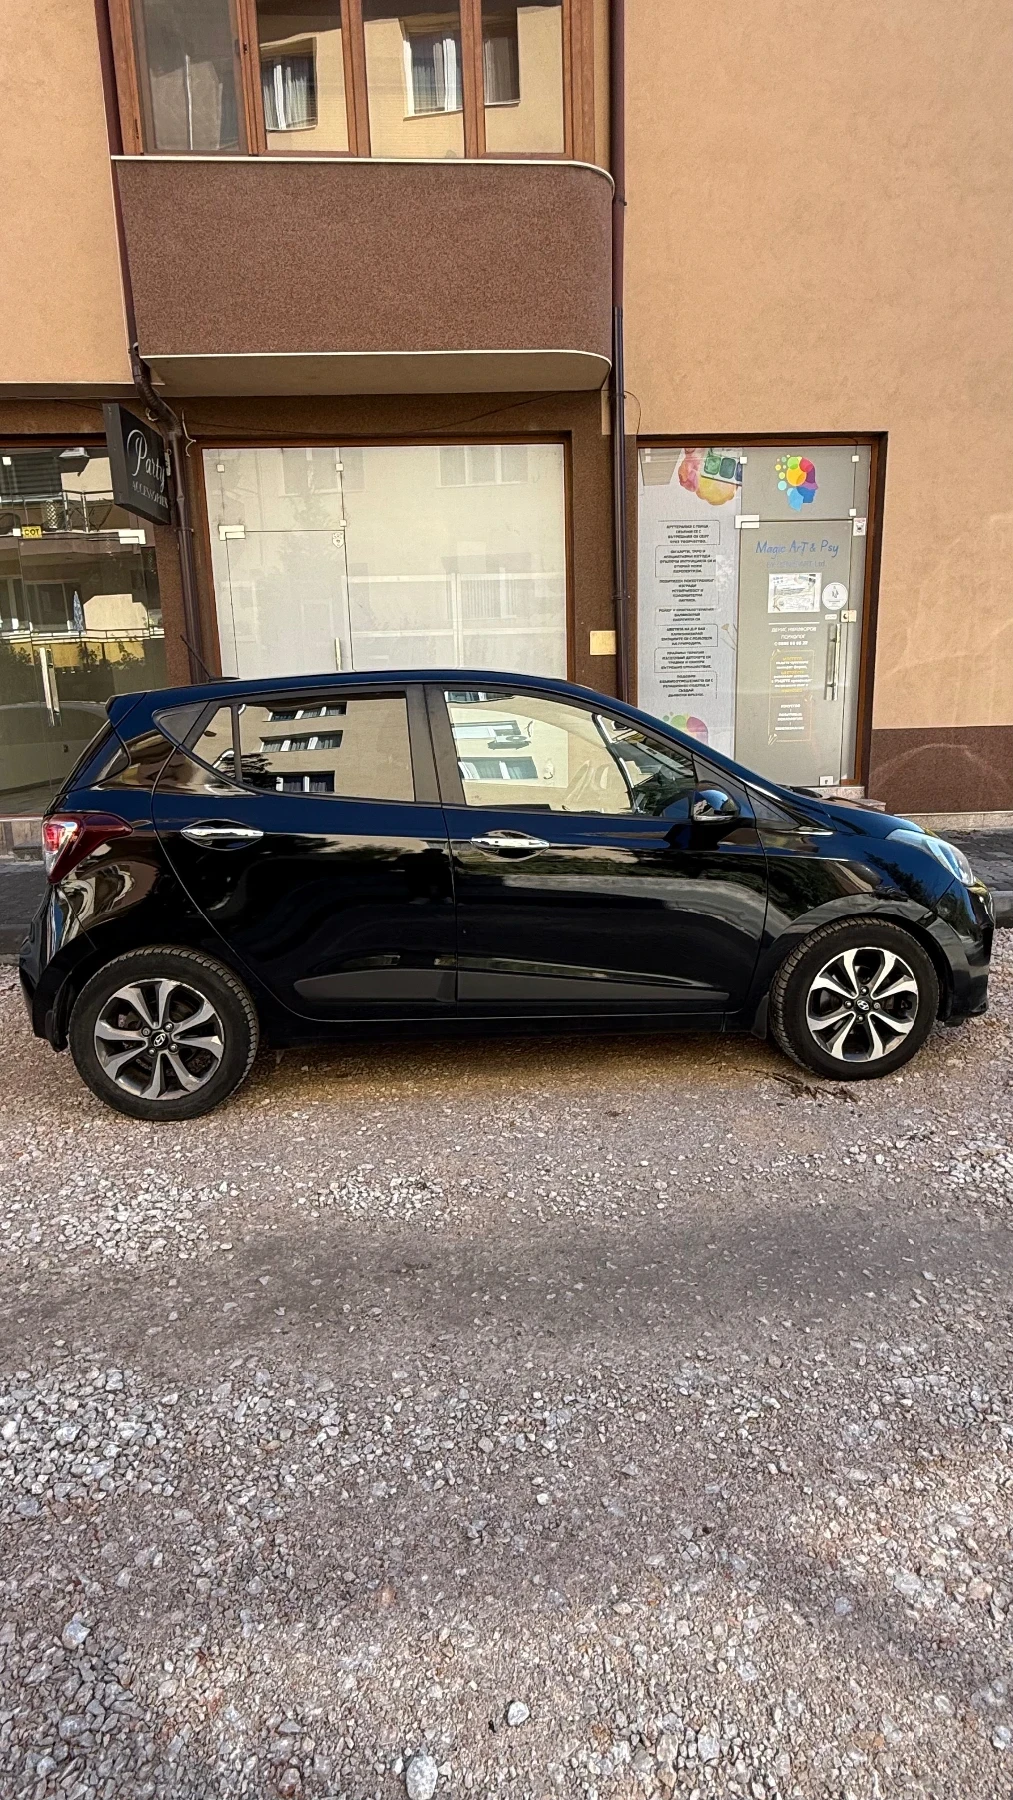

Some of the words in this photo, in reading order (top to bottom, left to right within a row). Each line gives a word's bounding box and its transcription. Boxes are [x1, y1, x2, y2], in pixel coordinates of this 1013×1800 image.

[127, 429, 165, 493] Party
[756, 539, 786, 560] Magic
[810, 542, 816, 553] &
[820, 539, 839, 558] Psy
